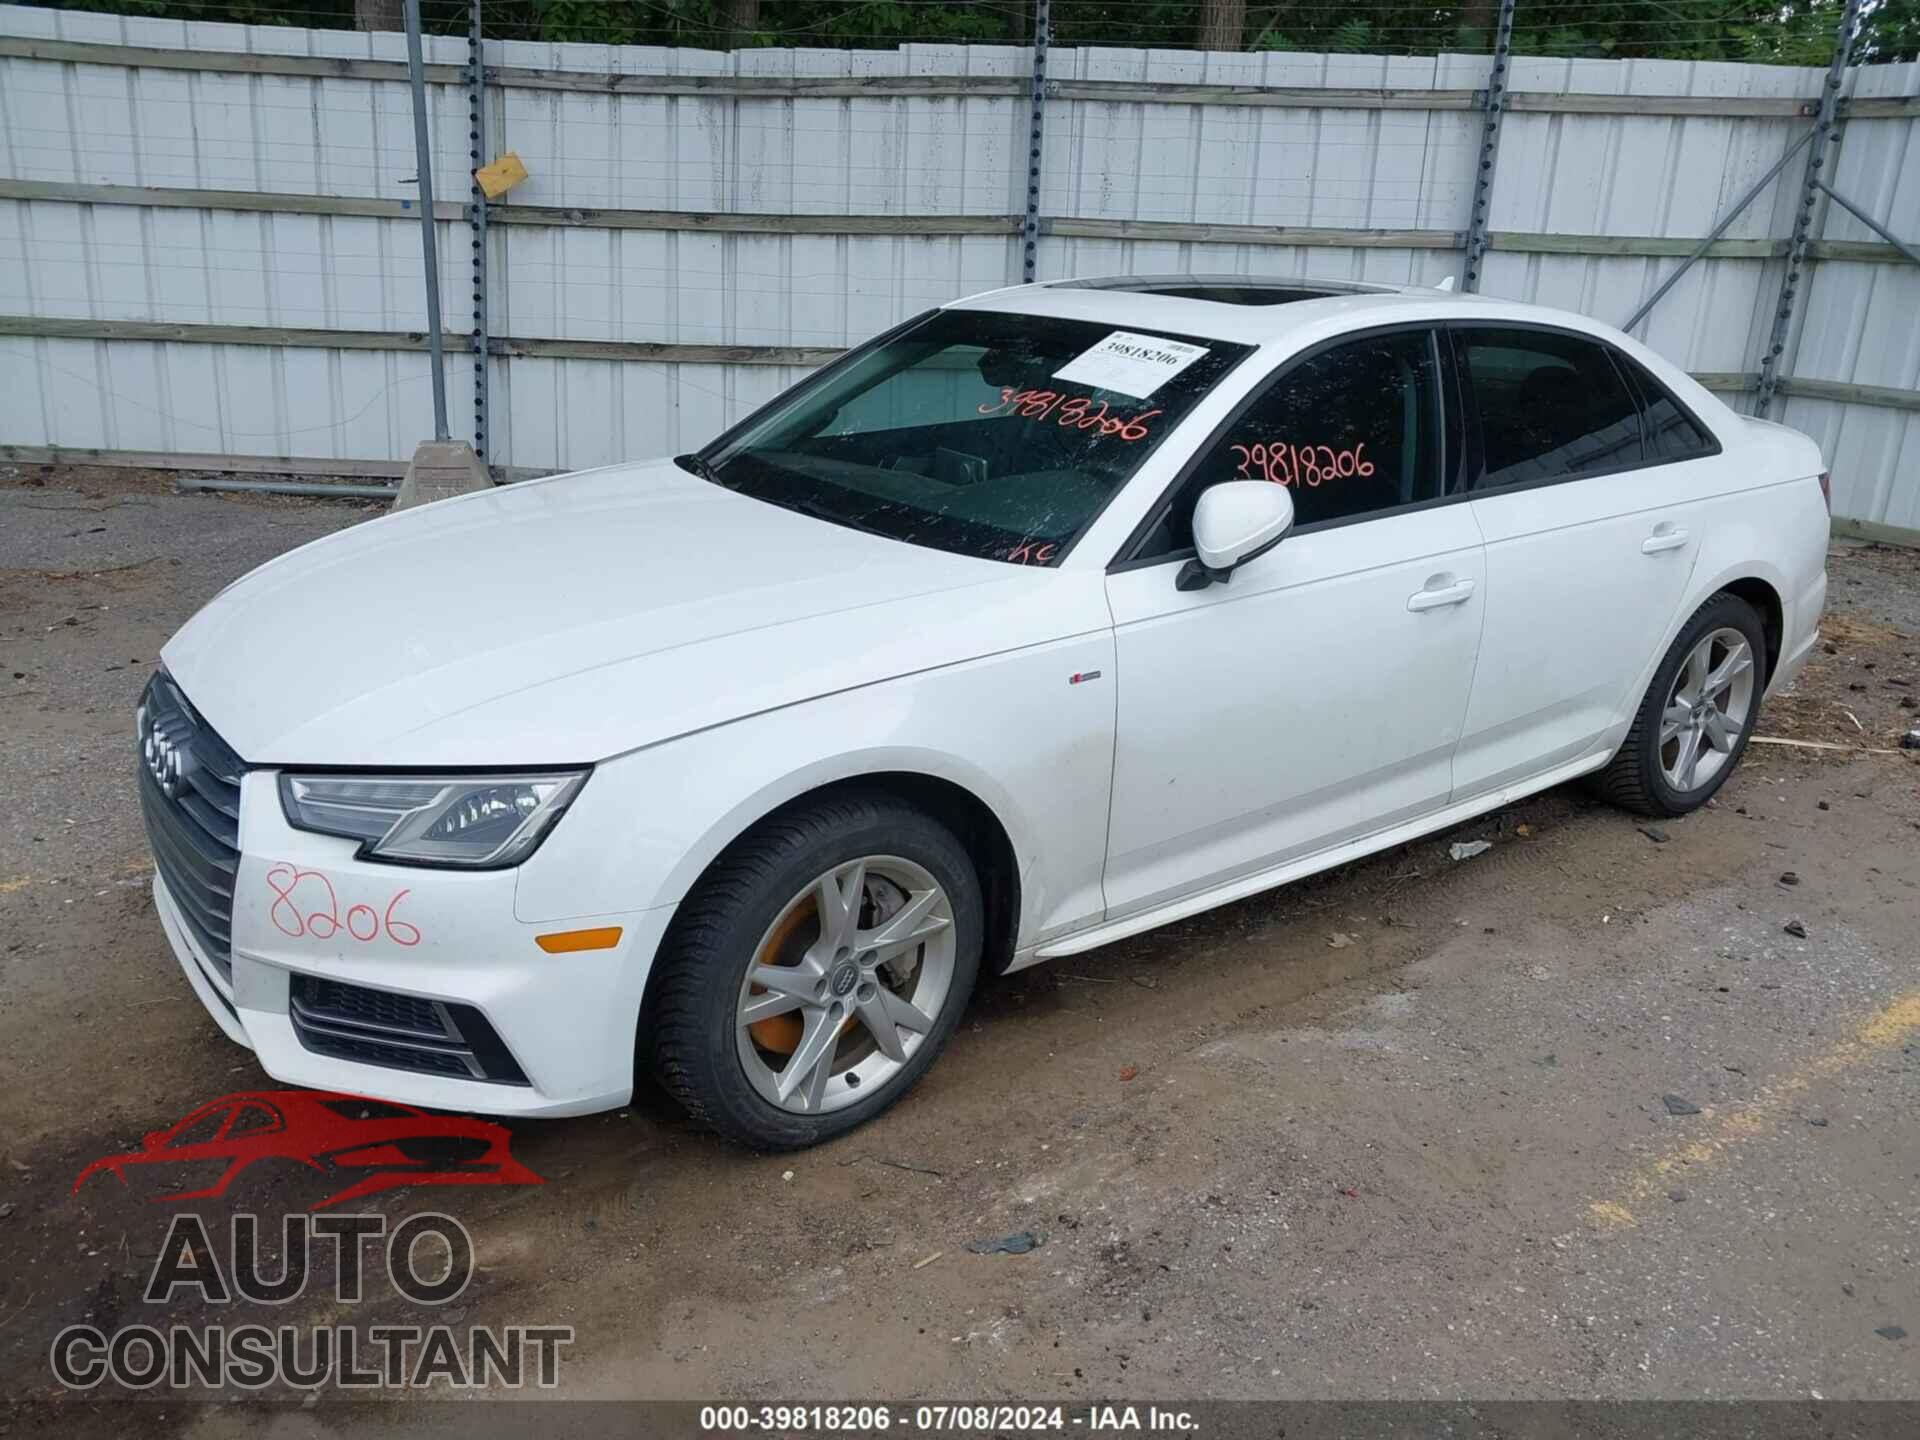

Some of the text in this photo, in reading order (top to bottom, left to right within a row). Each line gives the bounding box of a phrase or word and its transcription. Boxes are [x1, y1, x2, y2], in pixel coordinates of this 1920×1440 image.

[1102, 342, 1177, 366] 39818206
[978, 388, 1162, 440] 39818206
[266, 861, 421, 946] 8206
